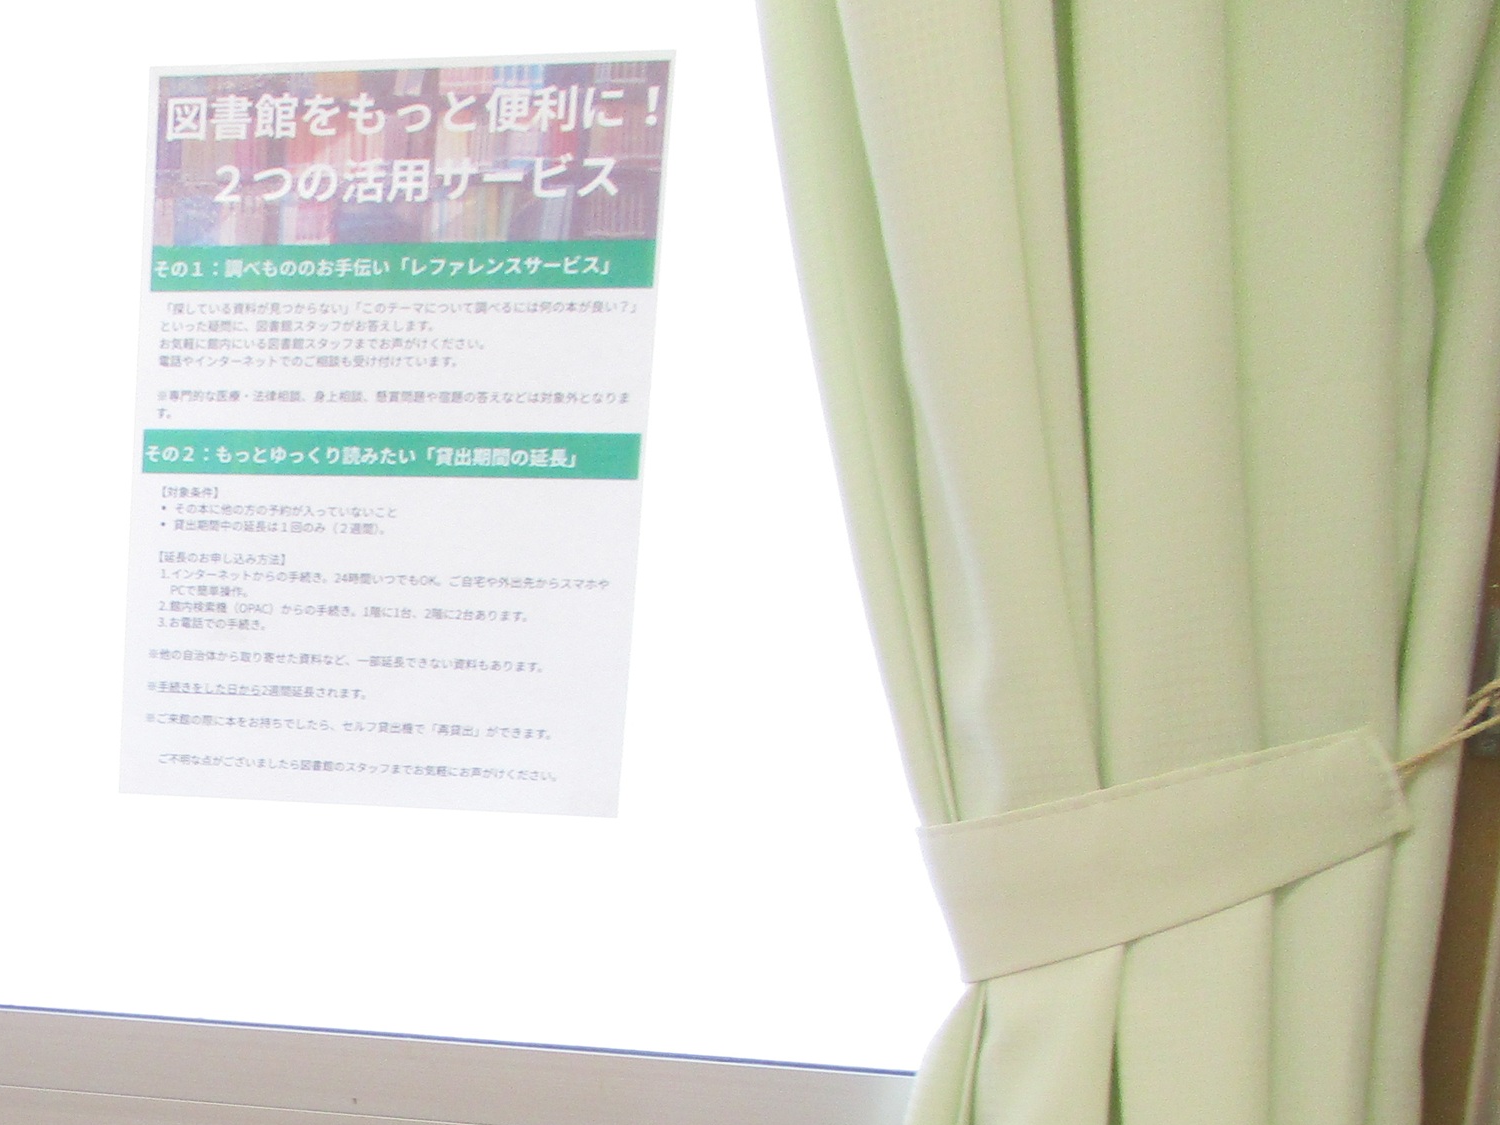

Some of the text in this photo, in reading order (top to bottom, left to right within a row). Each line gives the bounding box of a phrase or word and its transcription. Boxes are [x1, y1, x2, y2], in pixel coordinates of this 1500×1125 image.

[165, 84, 661, 142] 図書館をもっと便利に！
